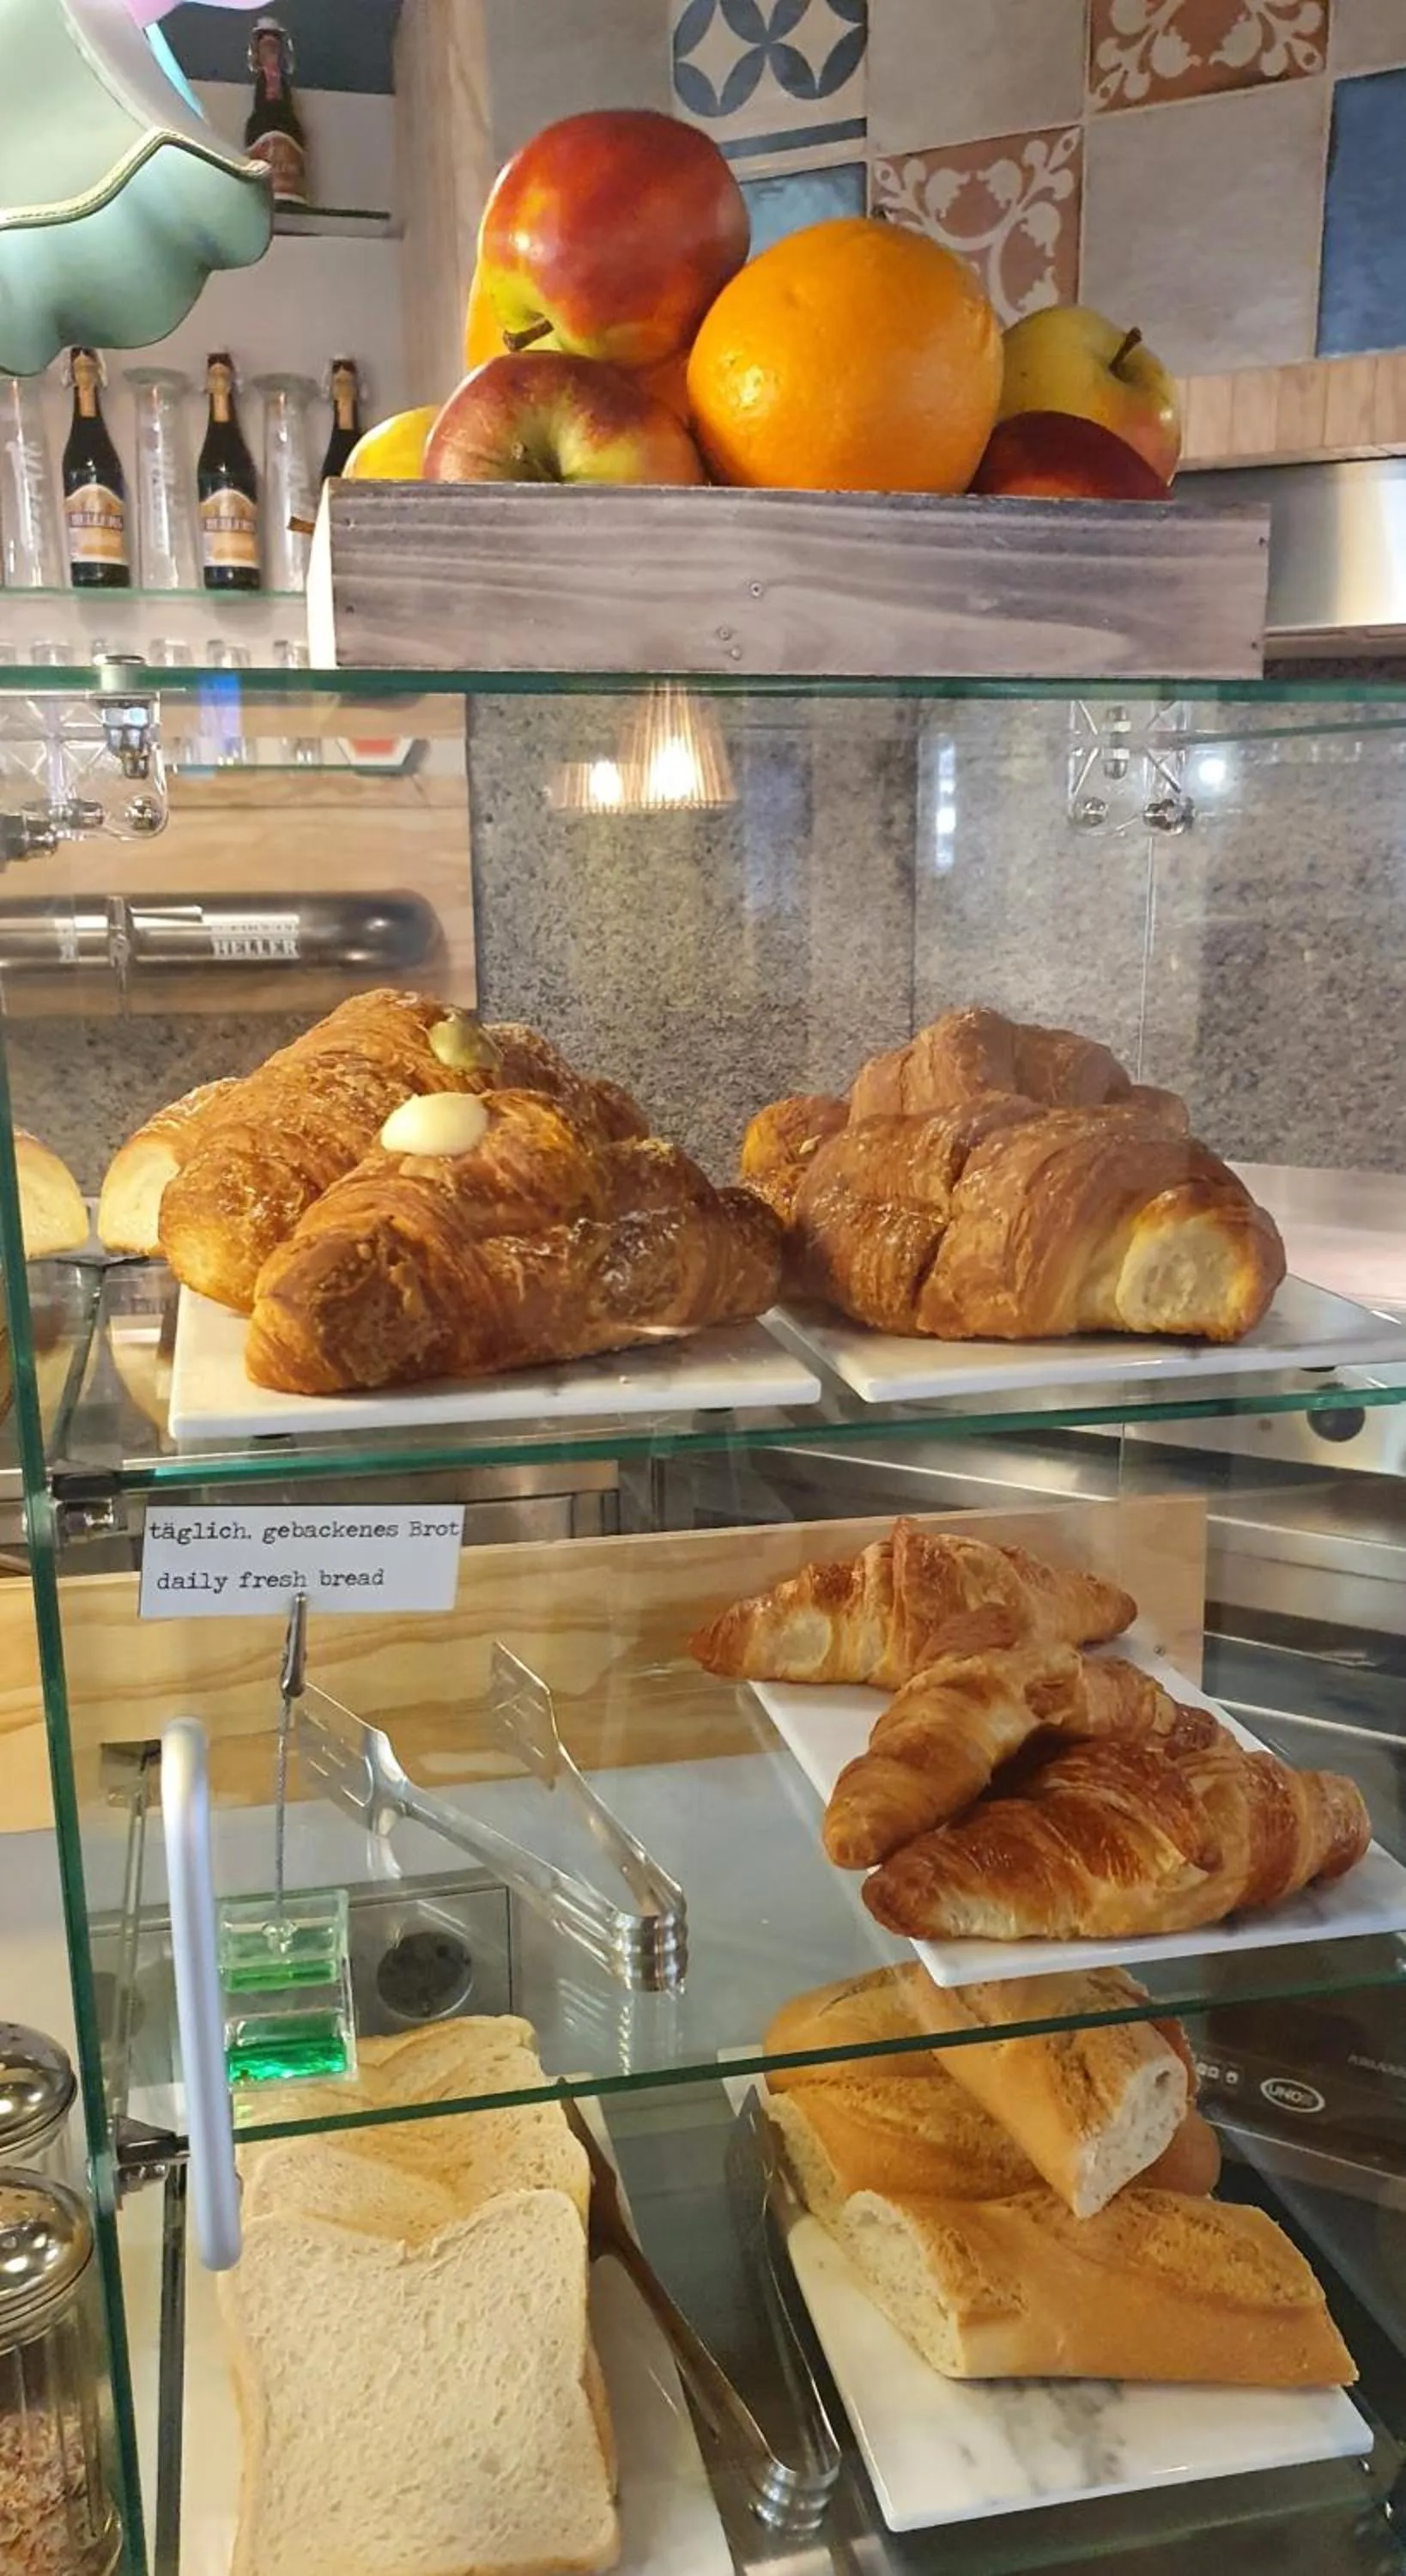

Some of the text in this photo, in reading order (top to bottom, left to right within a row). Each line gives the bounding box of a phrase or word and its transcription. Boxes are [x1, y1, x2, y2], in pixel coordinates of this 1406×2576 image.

[261, 1521, 400, 1545] gebackenes
[408, 1520, 460, 1538] Brot
[157, 1568, 385, 1595] daily fresh bread
